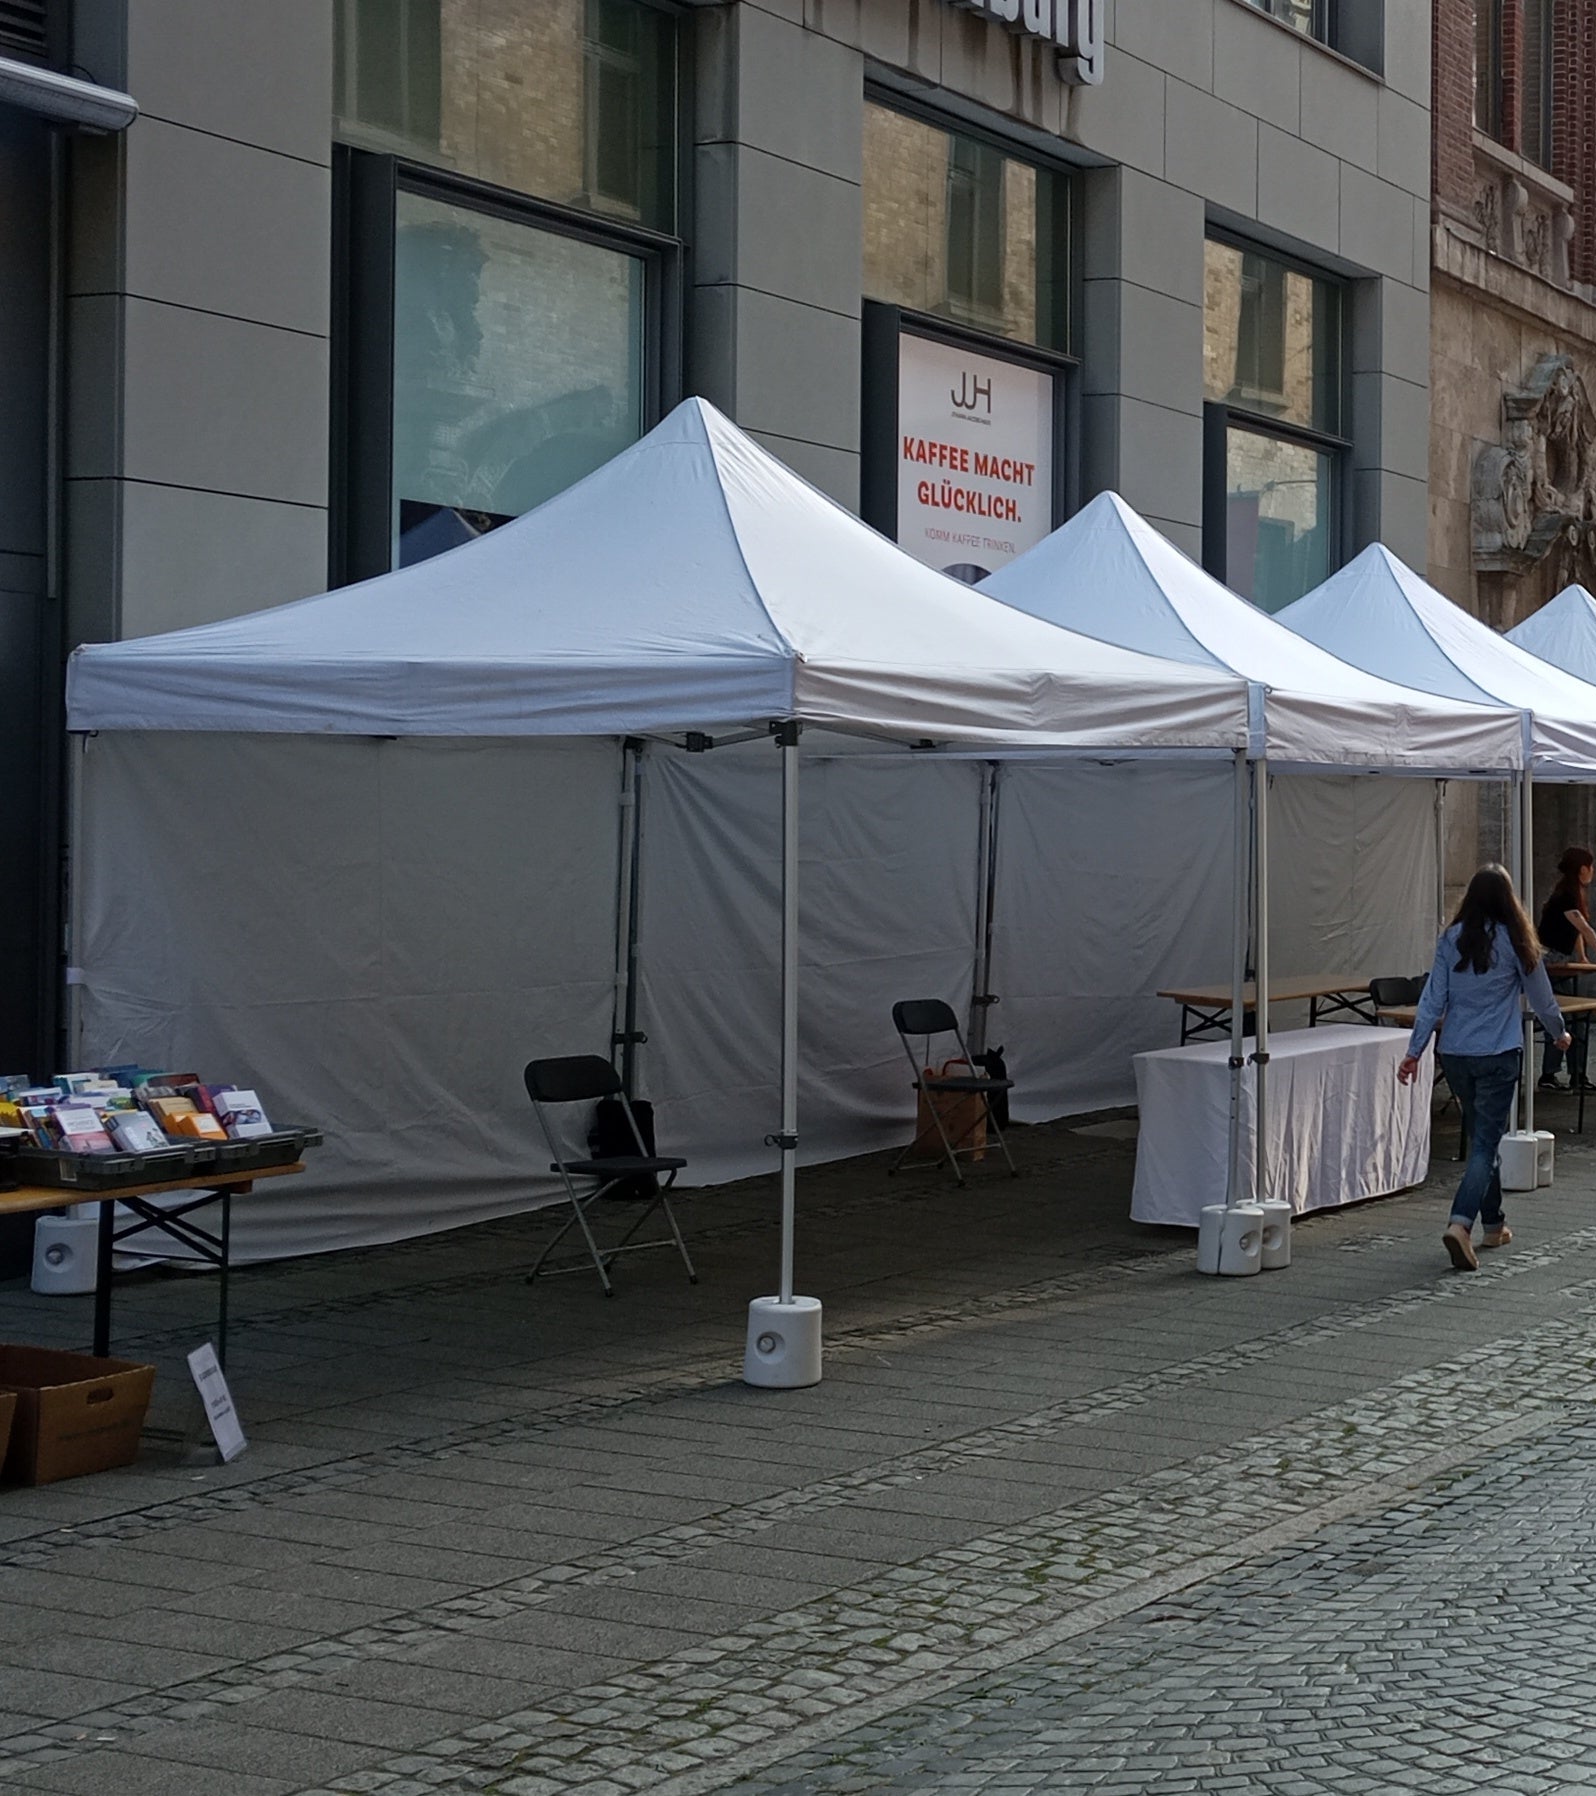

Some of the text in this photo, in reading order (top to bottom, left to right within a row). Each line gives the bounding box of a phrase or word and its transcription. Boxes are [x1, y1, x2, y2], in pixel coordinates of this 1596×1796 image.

[904, 436, 1035, 486] KAFFEE MACHT
[918, 479, 1021, 522] GLÜCKLICH.
